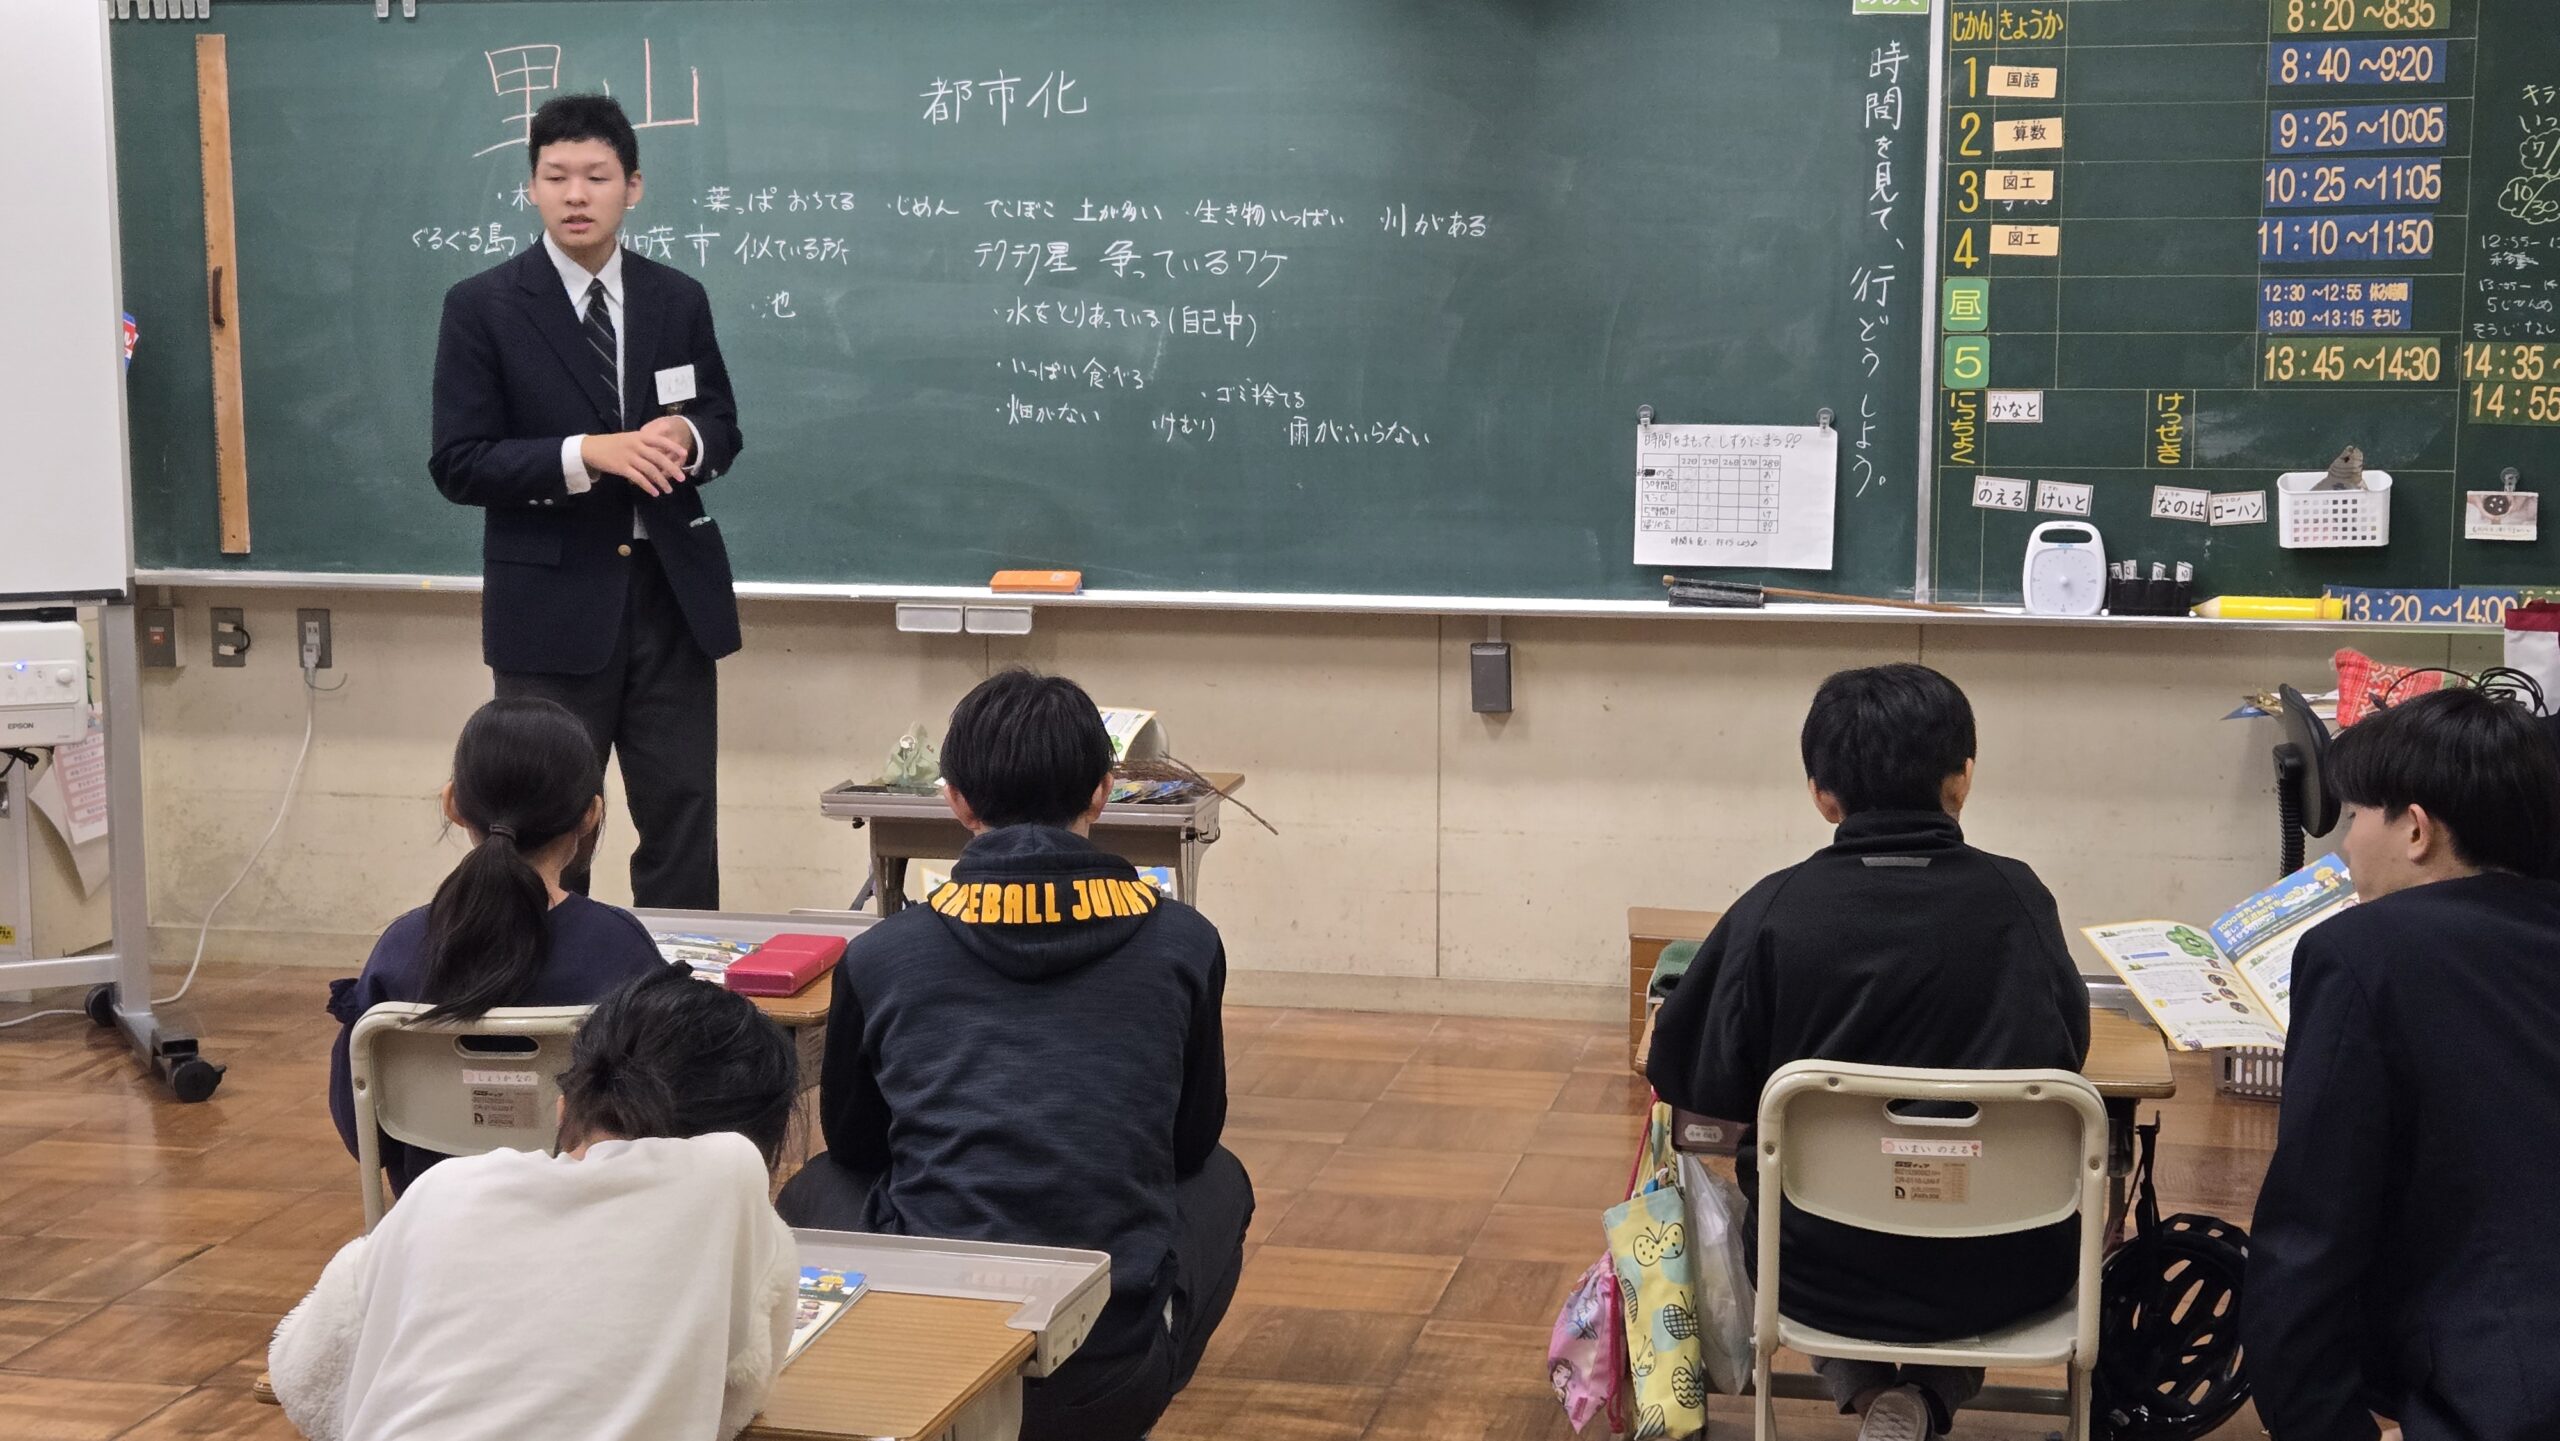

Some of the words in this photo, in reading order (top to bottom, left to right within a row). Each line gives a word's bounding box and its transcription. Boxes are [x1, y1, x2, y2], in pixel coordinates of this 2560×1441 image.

[1953, 10, 1993, 41] じかん
[1999, 9, 2064, 41] きょうか
[2287, 0, 2355, 33] 8:20
[1963, 57, 1977, 98] 1
[2006, 71, 2040, 88] 国語
[2281, 47, 2350, 84] 8:40
[919, 69, 1088, 126] 都市化
[1960, 112, 1982, 156] 2
[2013, 124, 2046, 141] 算数
[2280, 111, 2348, 148] 9:25
[1959, 170, 1979, 213] 3
[2003, 175, 2036, 190] 図工
[2265, 167, 2344, 203] 10:25
[703, 186, 778, 215] 葉っぱ
[1953, 226, 1979, 269] 4
[2008, 231, 2041, 246] 図工
[2258, 222, 2338, 257] 11:10
[974, 239, 1078, 286] テクテク星
[761, 289, 797, 319] 池
[1948, 289, 1982, 320] 昼
[2264, 284, 2305, 302] 12:30
[2268, 309, 2306, 327] 13:00
[2371, 308, 2402, 328] そうじ
[1953, 345, 1982, 377] 5
[2265, 346, 2345, 381] 13:45
[2464, 344, 2545, 381] 14:35
[1991, 400, 2037, 418] かなと
[1951, 391, 1977, 465] にっちょく
[2155, 392, 2184, 465] けっせき
[1978, 488, 2023, 507] のえる
[2041, 491, 2086, 511] けいと
[2158, 497, 2204, 517] なのは
[2213, 502, 2261, 519] ローハン
[8, 722, 34, 730] EPSON
[1899, 1144, 1931, 1153] いまい
[1937, 1145, 1969, 1154] のえる
